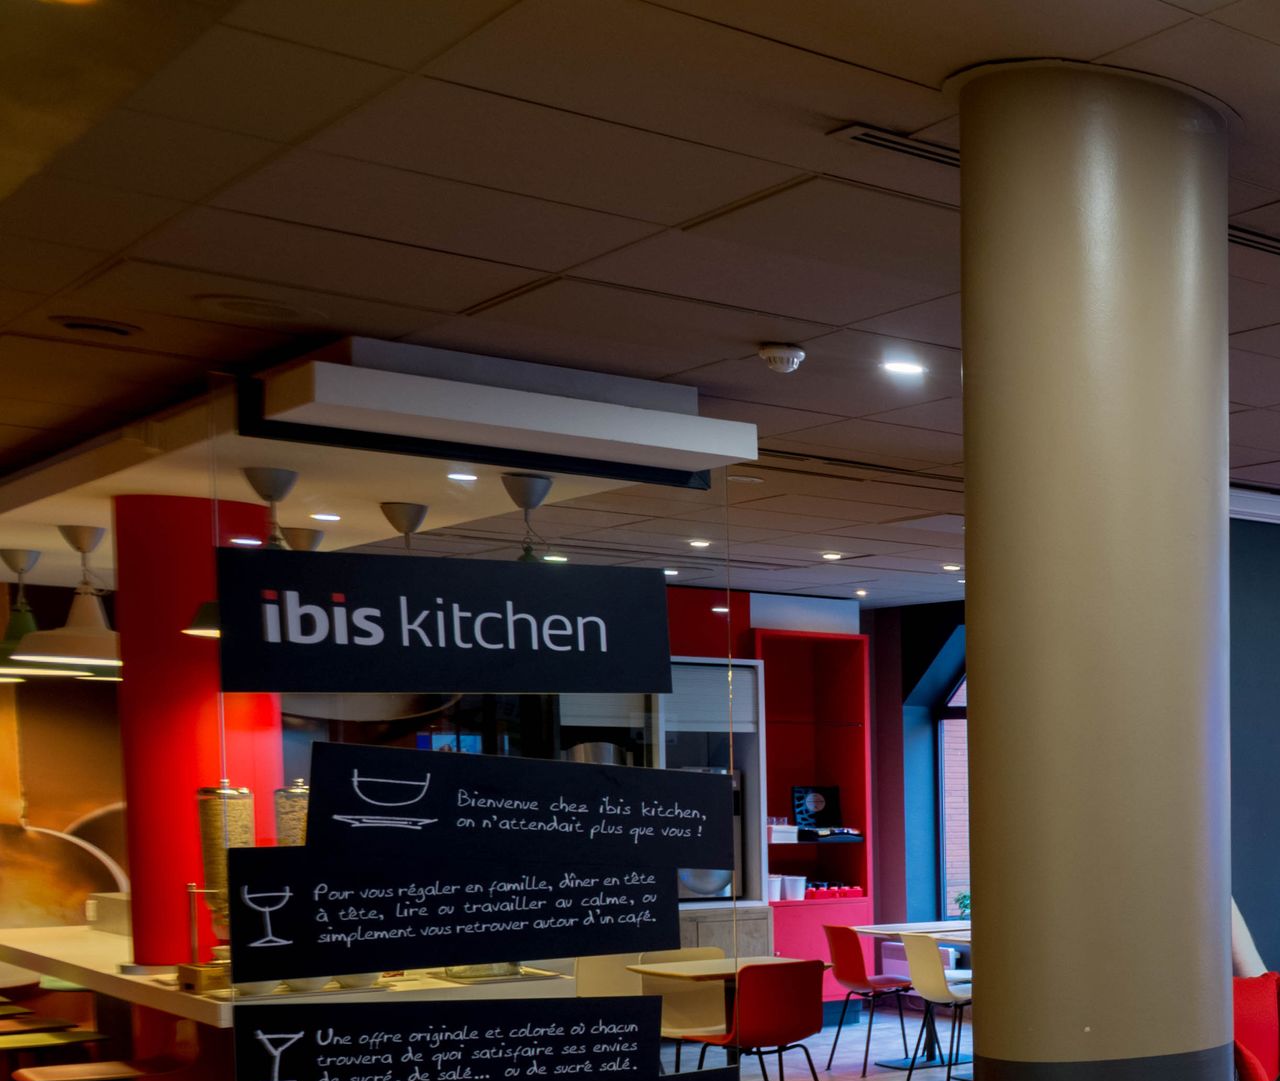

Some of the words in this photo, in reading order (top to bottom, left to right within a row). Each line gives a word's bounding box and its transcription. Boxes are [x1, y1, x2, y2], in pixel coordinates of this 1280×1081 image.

[261, 590, 385, 646] ibis
[399, 596, 608, 653] kitchen
[458, 789, 539, 810] Bienvenue
[550, 796, 589, 813] chez
[600, 796, 632, 816] ibis
[642, 801, 707, 821] kitchen,
[456, 817, 475, 828] on
[591, 819, 623, 839] plus
[630, 826, 654, 844] que
[662, 827, 691, 837] vous
[697, 826, 702, 837] !
[313, 883, 354, 901] Pour
[360, 885, 394, 899] vous
[398, 881, 461, 902] régaler
[465, 882, 483, 894] en
[487, 875, 553, 898] famille,
[559, 873, 599, 887] dîner
[604, 875, 620, 886] en
[624, 872, 656, 884] tête
[316, 907, 329, 922] à
[339, 906, 384, 922] tête,
[438, 904, 455, 916] ou
[464, 896, 547, 914] travailler
[556, 897, 572, 909] au
[580, 891, 634, 909] calme,
[642, 893, 657, 904] ou
[317, 925, 416, 948] simplement
[420, 924, 451, 936] vous
[455, 918, 529, 934] retrouver
[533, 916, 579, 929] autour
[618, 909, 656, 927] café.
[316, 1028, 352, 1046] Une
[359, 1030, 403, 1049] offre
[408, 1025, 479, 1048] originale
[484, 1026, 504, 1040] et
[508, 1022, 565, 1038] colorée
[570, 1022, 586, 1036] où
[590, 1020, 638, 1035] chacun
[317, 1052, 393, 1066] trouvera
[401, 1047, 423, 1062] de
[433, 1044, 463, 1071] quoi
[471, 1041, 554, 1059] satisfaire
[561, 1043, 586, 1055] ses
[593, 1037, 637, 1052] envies
[408, 1067, 430, 1081] de
[504, 1065, 519, 1077] ou
[526, 1060, 547, 1075] de
[554, 1061, 593, 1074] sucré
[599, 1058, 638, 1072] salé.
